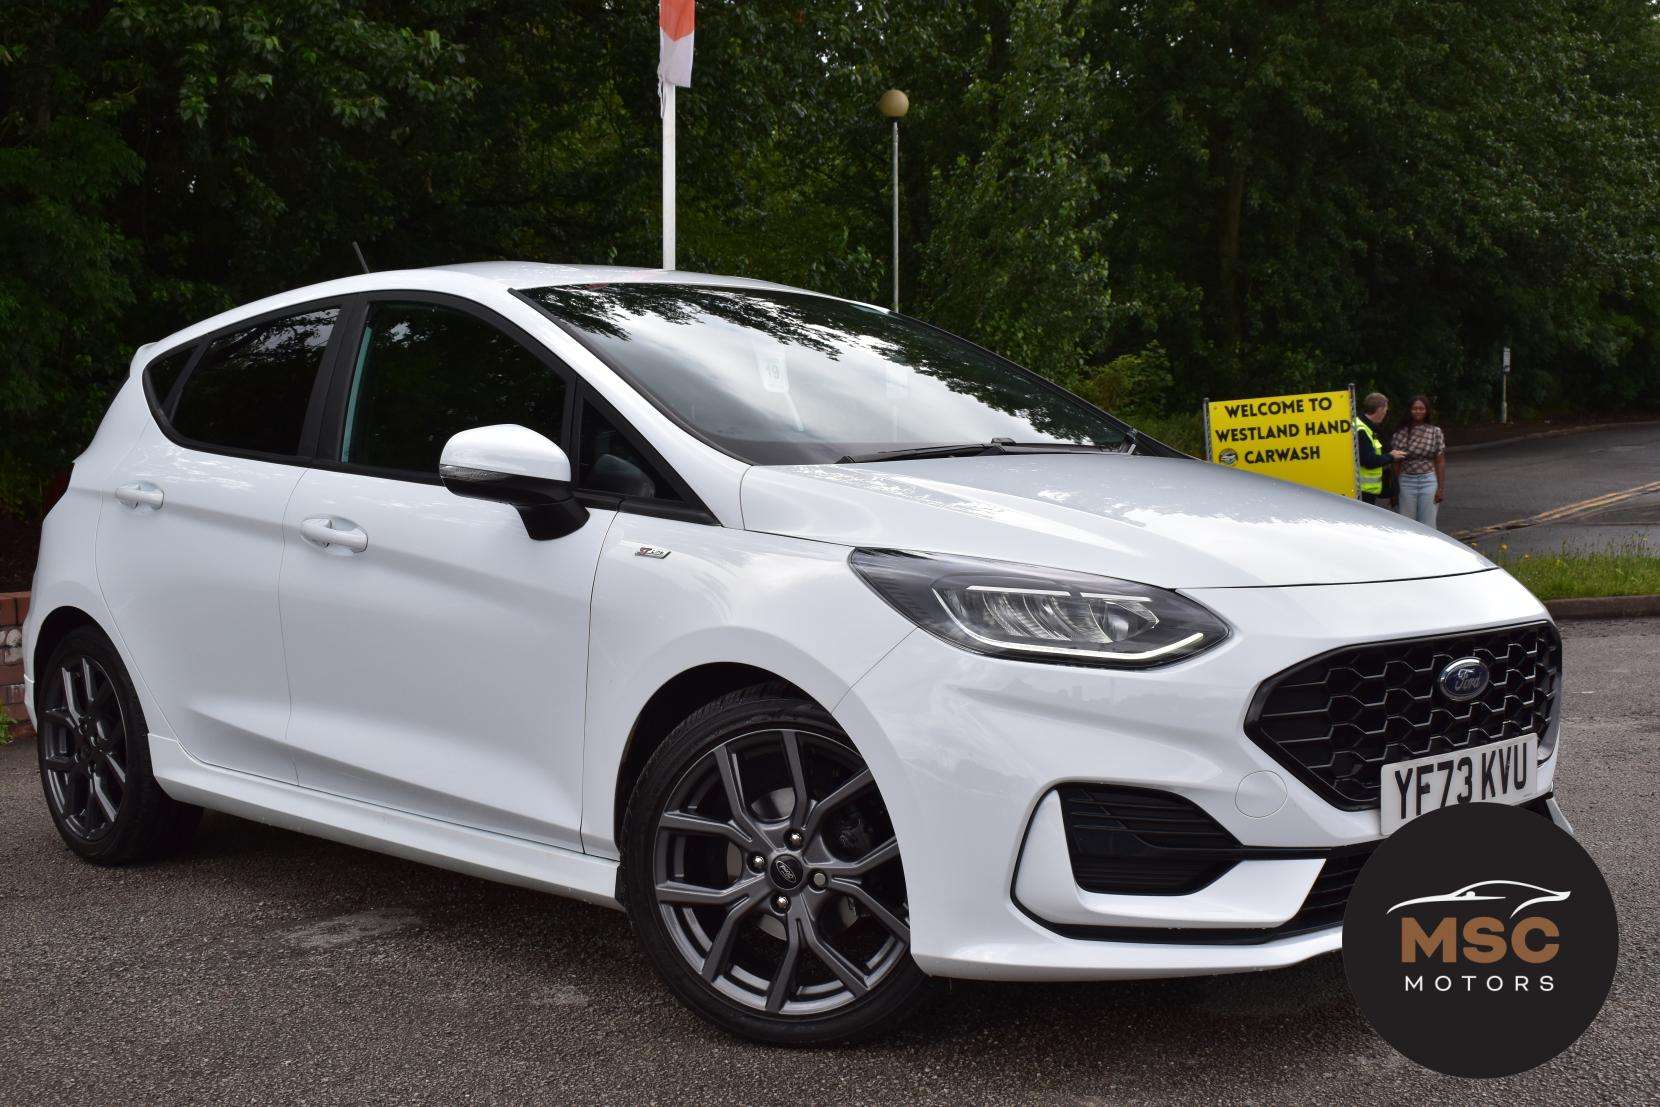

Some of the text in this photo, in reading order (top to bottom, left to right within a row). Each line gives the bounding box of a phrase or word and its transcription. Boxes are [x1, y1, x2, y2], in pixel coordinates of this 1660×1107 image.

[1225, 397, 1332, 418] WELCOME TO
[1215, 419, 1350, 442] WESTLAND HAND
[1244, 446, 1320, 464] CARWASH
[1455, 668, 1480, 691] Ford
[1394, 742, 1527, 820] YF73 KVU
